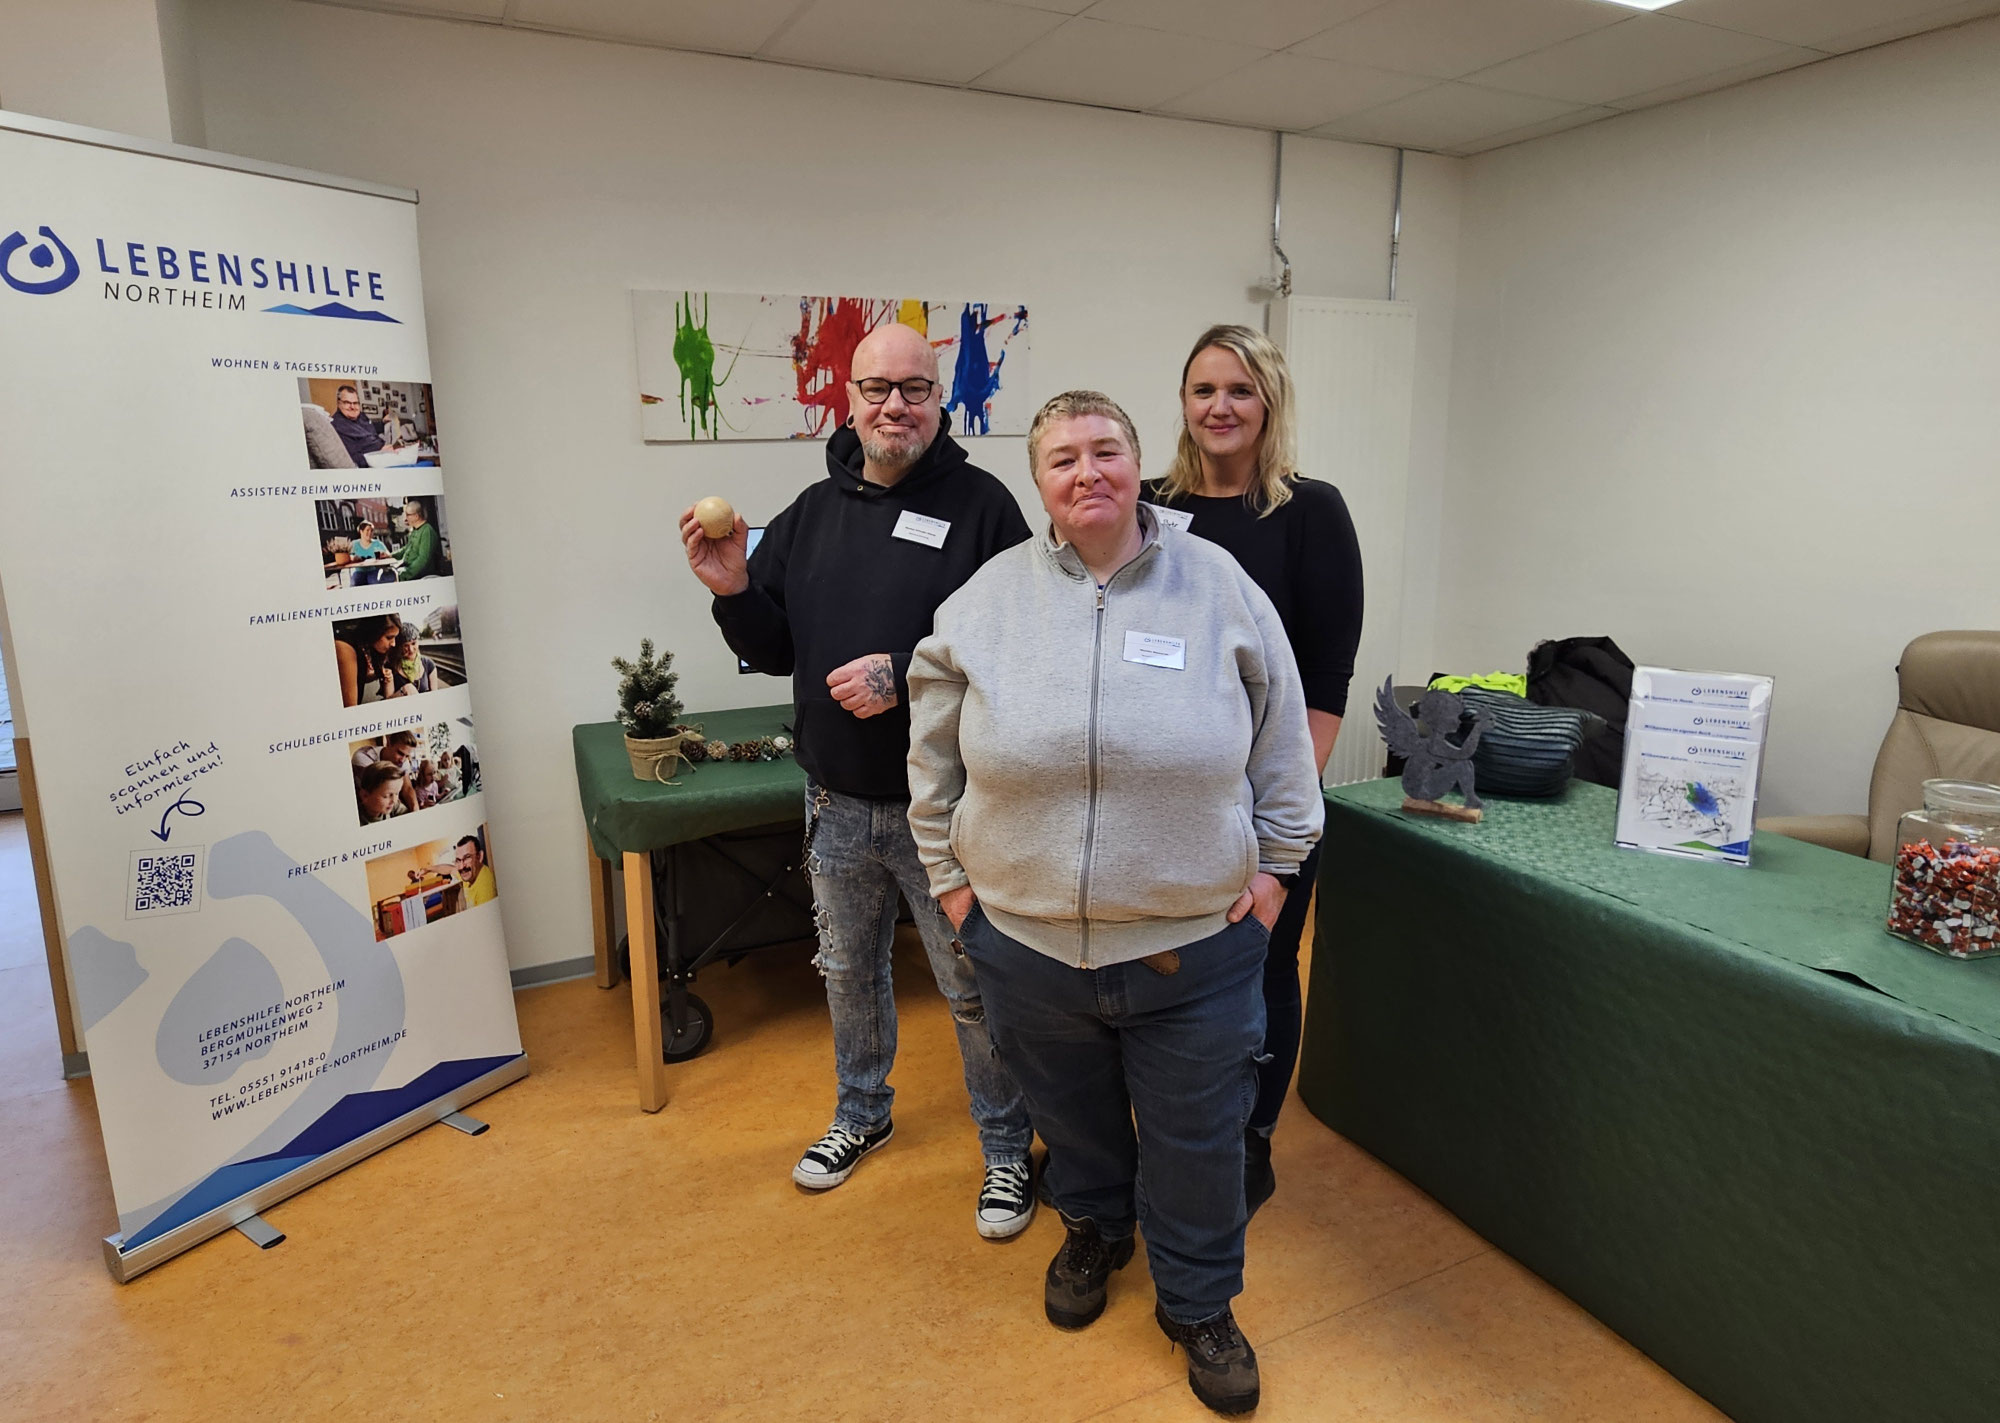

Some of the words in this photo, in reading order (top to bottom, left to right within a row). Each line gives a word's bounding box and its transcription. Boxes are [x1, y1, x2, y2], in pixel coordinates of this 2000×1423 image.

[96, 238, 385, 301] LEBENSHILFE
[104, 282, 246, 311] NORTHEIM
[212, 358, 269, 370] WOHNEN
[273, 361, 281, 370] &
[285, 361, 379, 375] TAGESSTRUKTUR
[230, 486, 297, 498] ASSISTENZ
[301, 485, 328, 495] BEIM
[332, 483, 382, 494] WOHNEN
[249, 599, 392, 625] FAMILIENENTLASTENDER
[395, 595, 431, 608] DIENST
[1703, 688, 1748, 696] LEBENSHILFE
[269, 722, 383, 754] SCHULBEGLEITENDE
[386, 714, 423, 729] HILFEN
[1700, 747, 1745, 757] LEBENSHILFE
[109, 763, 180, 802] scannen
[187, 741, 219, 764] und
[125, 740, 190, 777] Einfach
[115, 754, 223, 815] informieren!
[288, 855, 338, 879] FREIZEIT
[341, 853, 349, 862] &
[352, 840, 392, 859] KULTUR
[199, 1003, 281, 1043] LEBENSHILFE
[285, 979, 346, 1009] NORTHEIM
[201, 1005, 313, 1056] BERGMÜHLENWEG
[316, 1001, 324, 1010] 2
[202, 1048, 241, 1070] 37154
[245, 1019, 309, 1052] NORTHEIM
[210, 1090, 236, 1108] TEL.
[239, 1073, 276, 1095] 05551
[280, 1052, 327, 1079] 91418-0
[211, 1028, 408, 1121] WWW.LEBENSHILFE-NORTHEIM.DE
